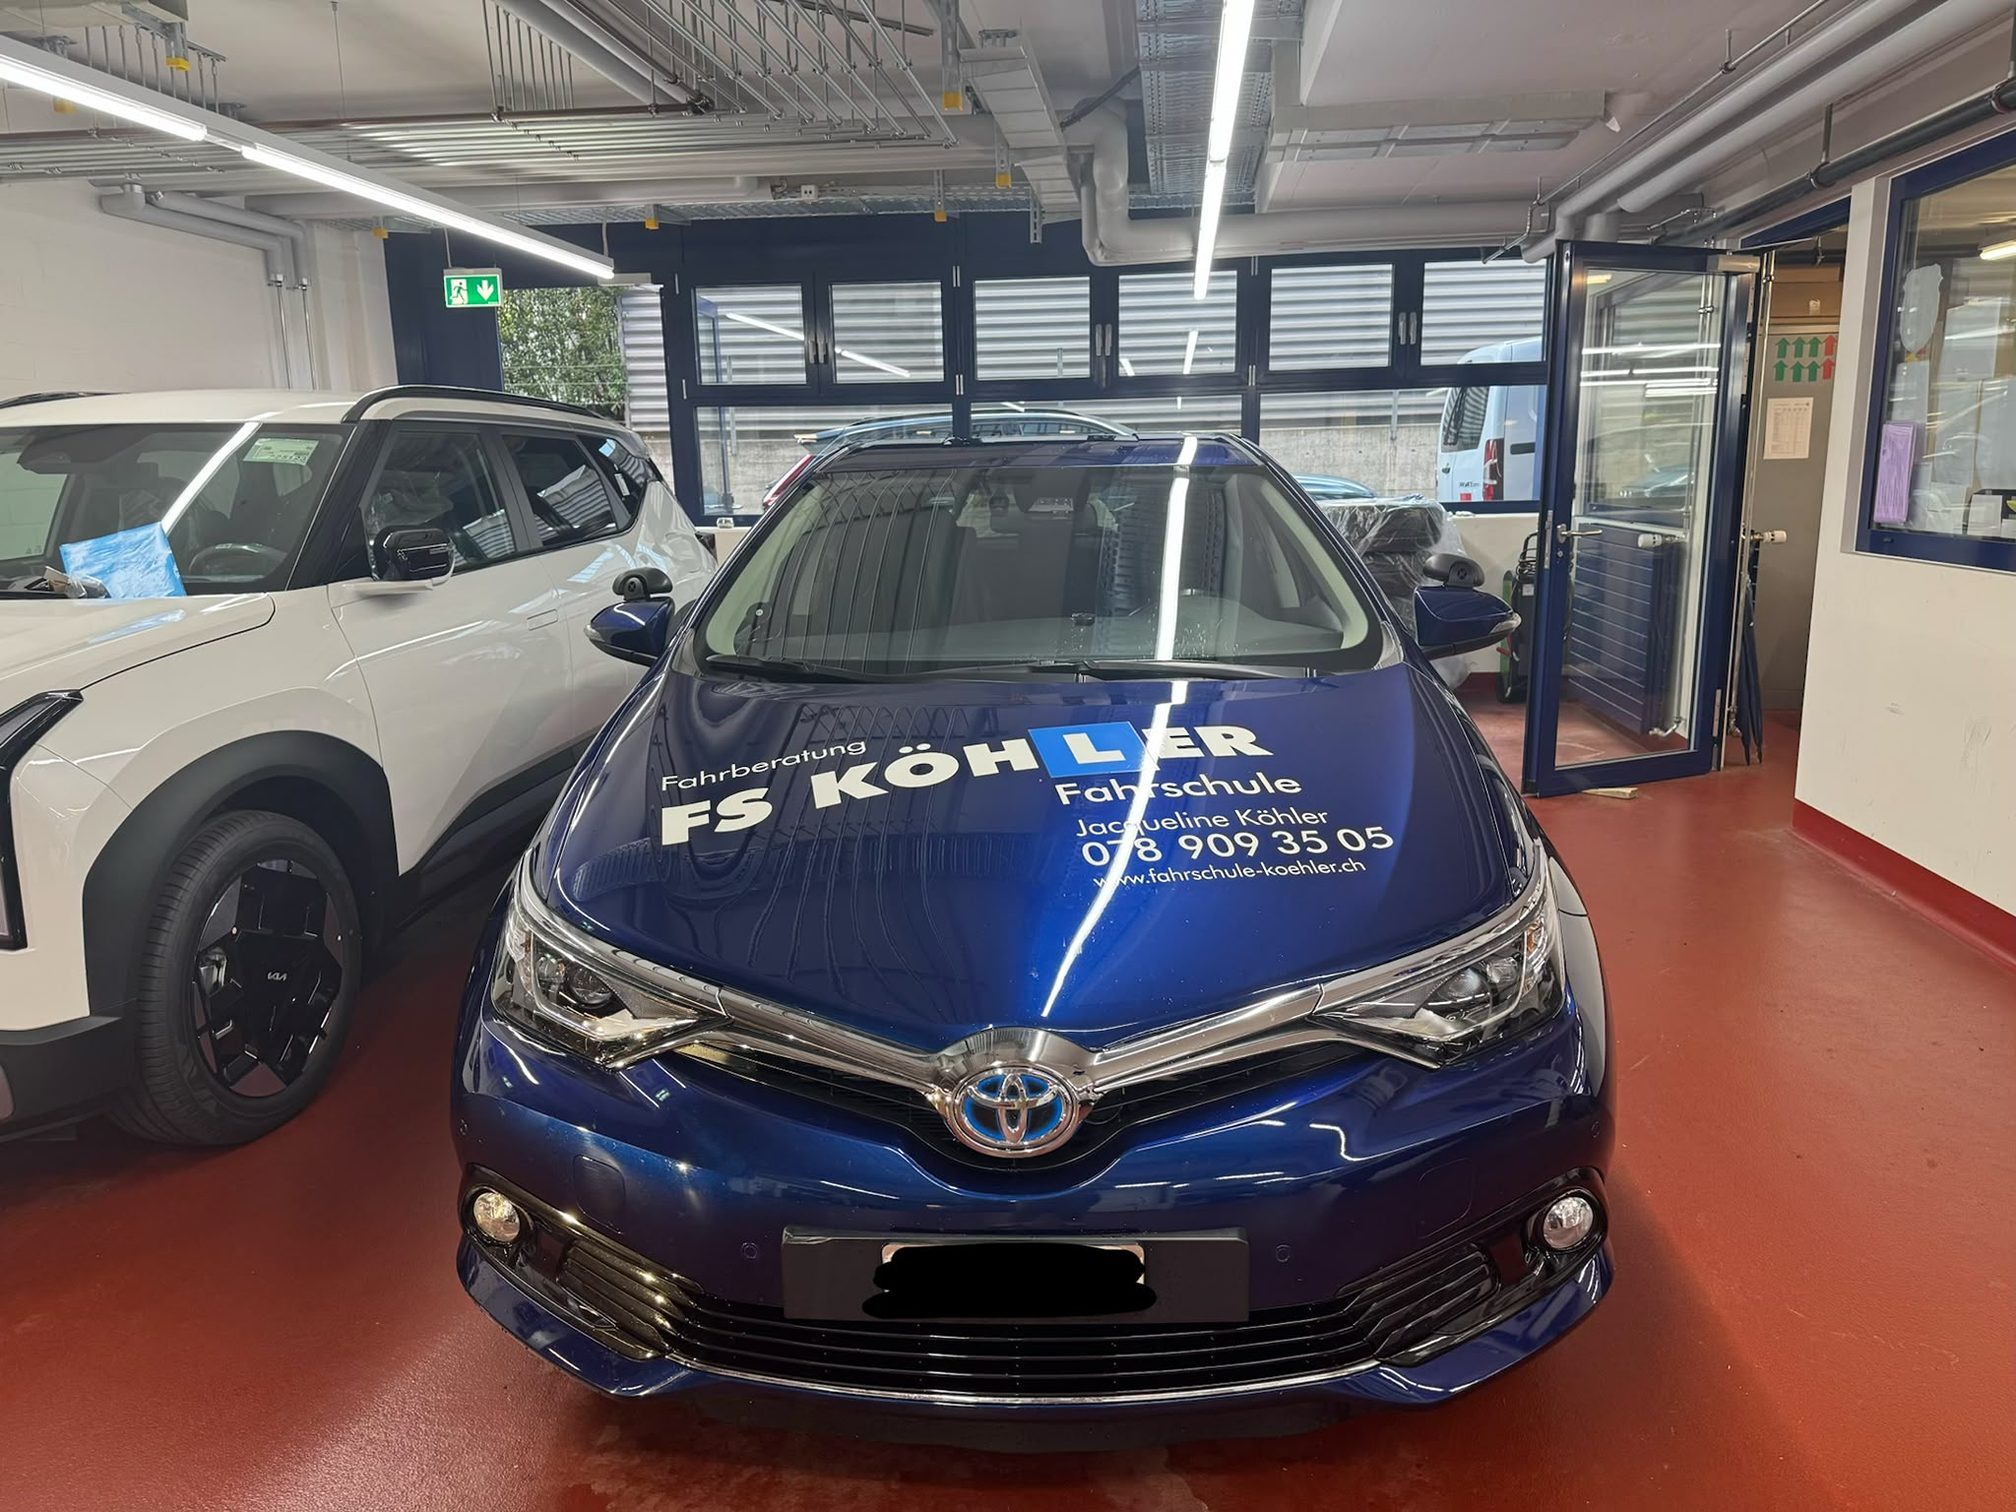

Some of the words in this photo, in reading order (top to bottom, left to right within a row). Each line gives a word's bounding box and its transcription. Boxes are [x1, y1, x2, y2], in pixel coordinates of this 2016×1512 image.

[662, 741, 866, 791] Fahrberatung
[662, 788, 773, 846] FS
[811, 725, 1274, 809] KÖHLER
[1055, 772, 1302, 805] Fahrschule
[1076, 811, 1229, 837] Jacqueline
[1235, 806, 1329, 829] Köhler
[1178, 833, 1259, 859] 909
[1271, 829, 1329, 855] 35
[1336, 826, 1394, 853] 05
